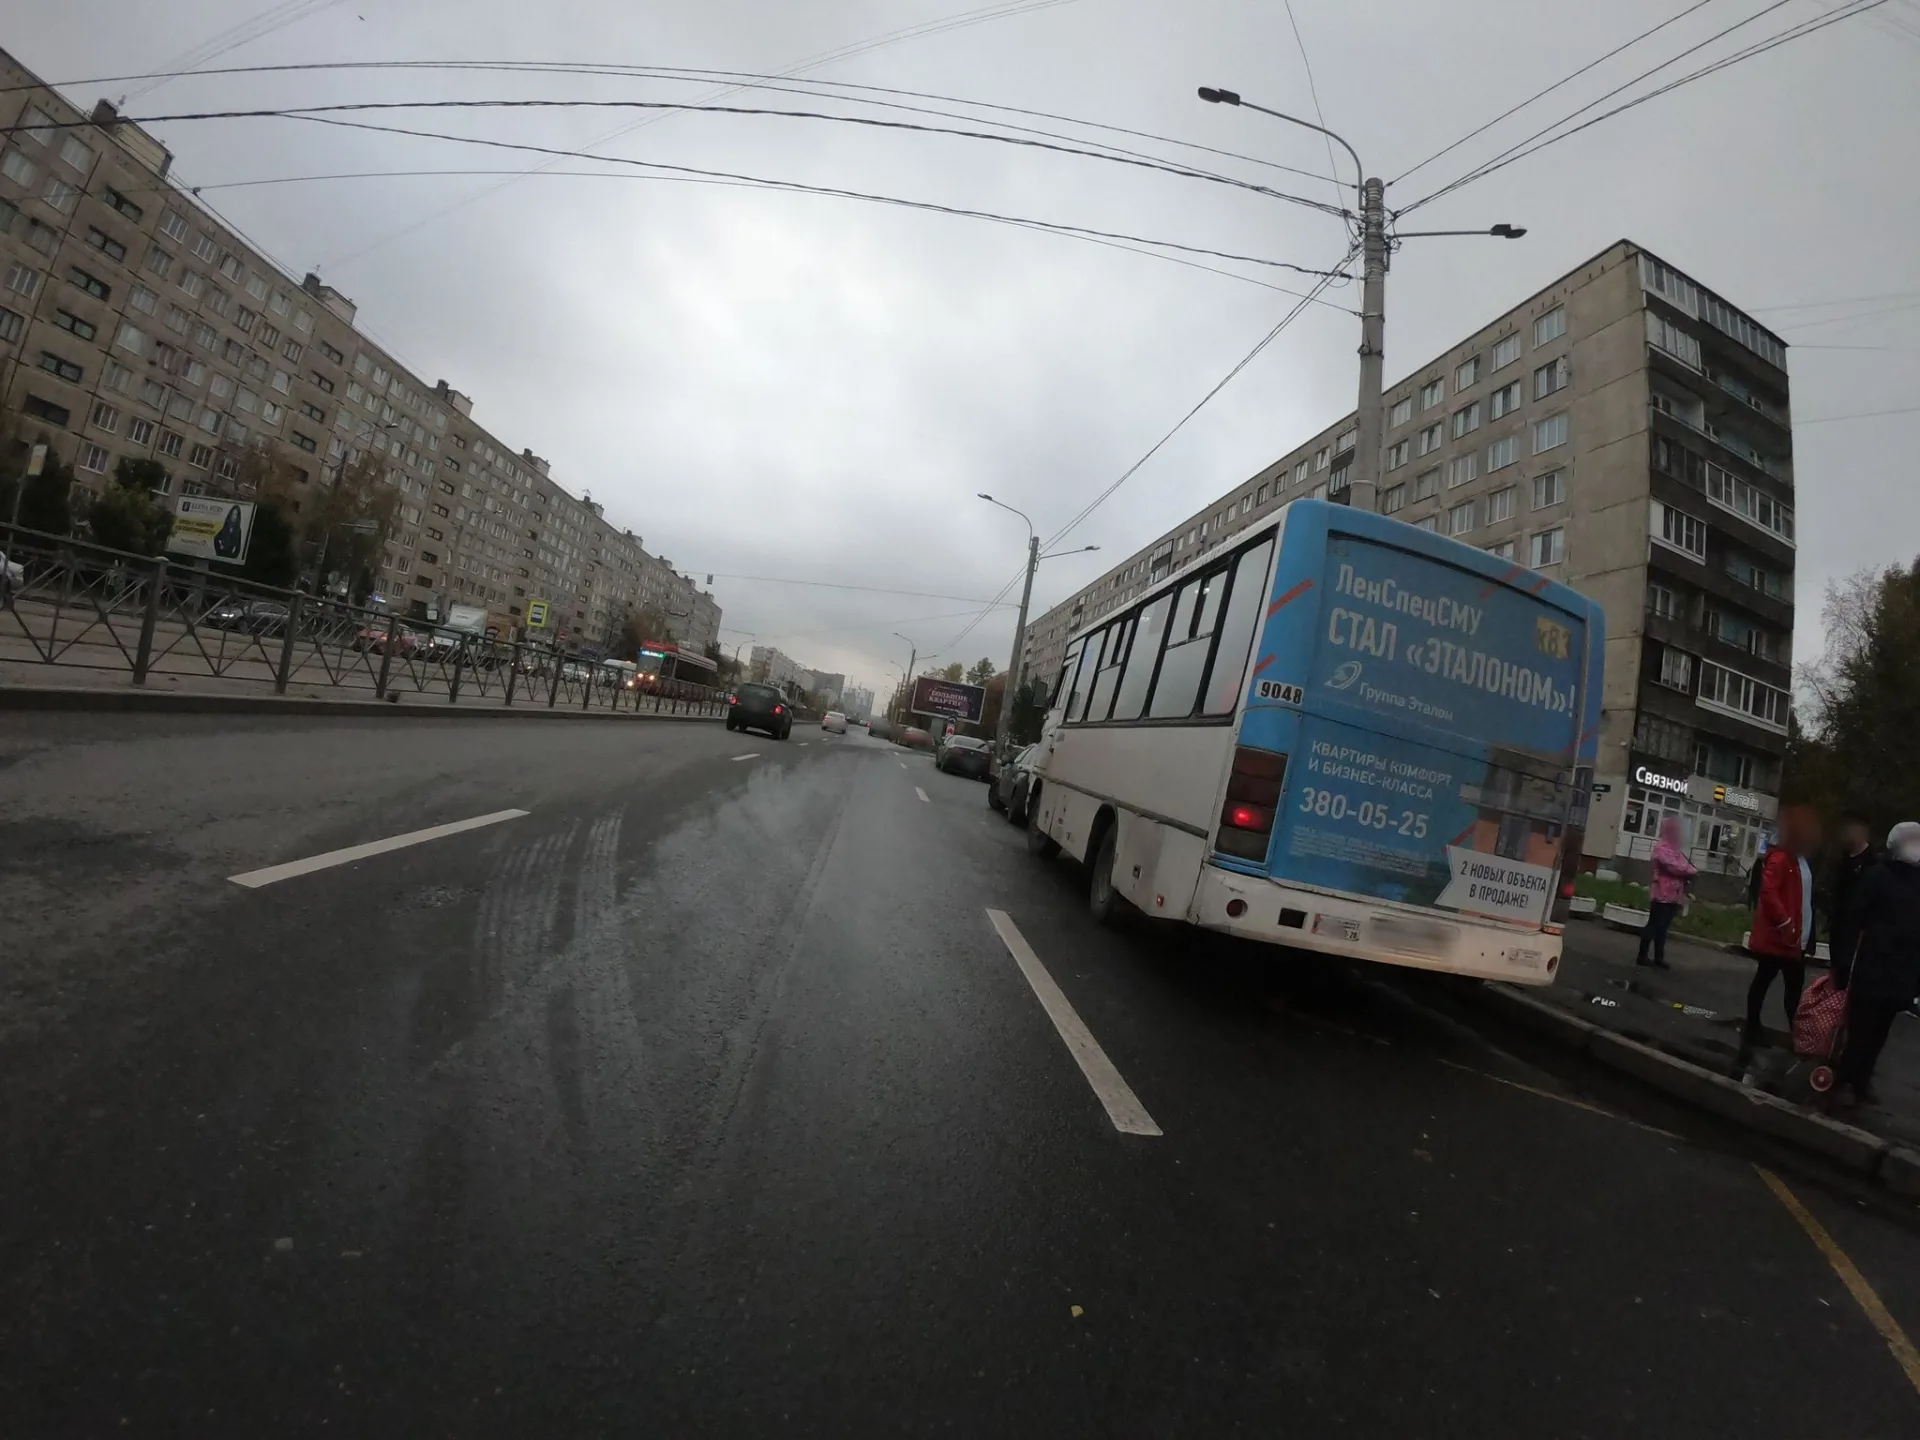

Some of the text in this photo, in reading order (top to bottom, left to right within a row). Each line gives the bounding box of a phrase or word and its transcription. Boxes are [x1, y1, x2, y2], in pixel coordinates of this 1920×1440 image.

[1335, 563, 1483, 636] ЛенСпецСМУ
[1328, 607, 1576, 718] СТАЛ «ЭТАЛОНОМ»!
[1260, 681, 1303, 705] 9048
[1360, 682, 1453, 720] Группа Эталон
[1308, 757, 1434, 801] И БИЗНЕС-КЛАССА
[1311, 740, 1453, 787] КВАРТИРЫ КОМФОРТ
[1299, 786, 1430, 839] 380-05-25
[1460, 860, 1547, 893] 2 НОВЫХ ОБЪЕКТА
[1469, 883, 1530, 909] В ПРОДАЖЕ!
